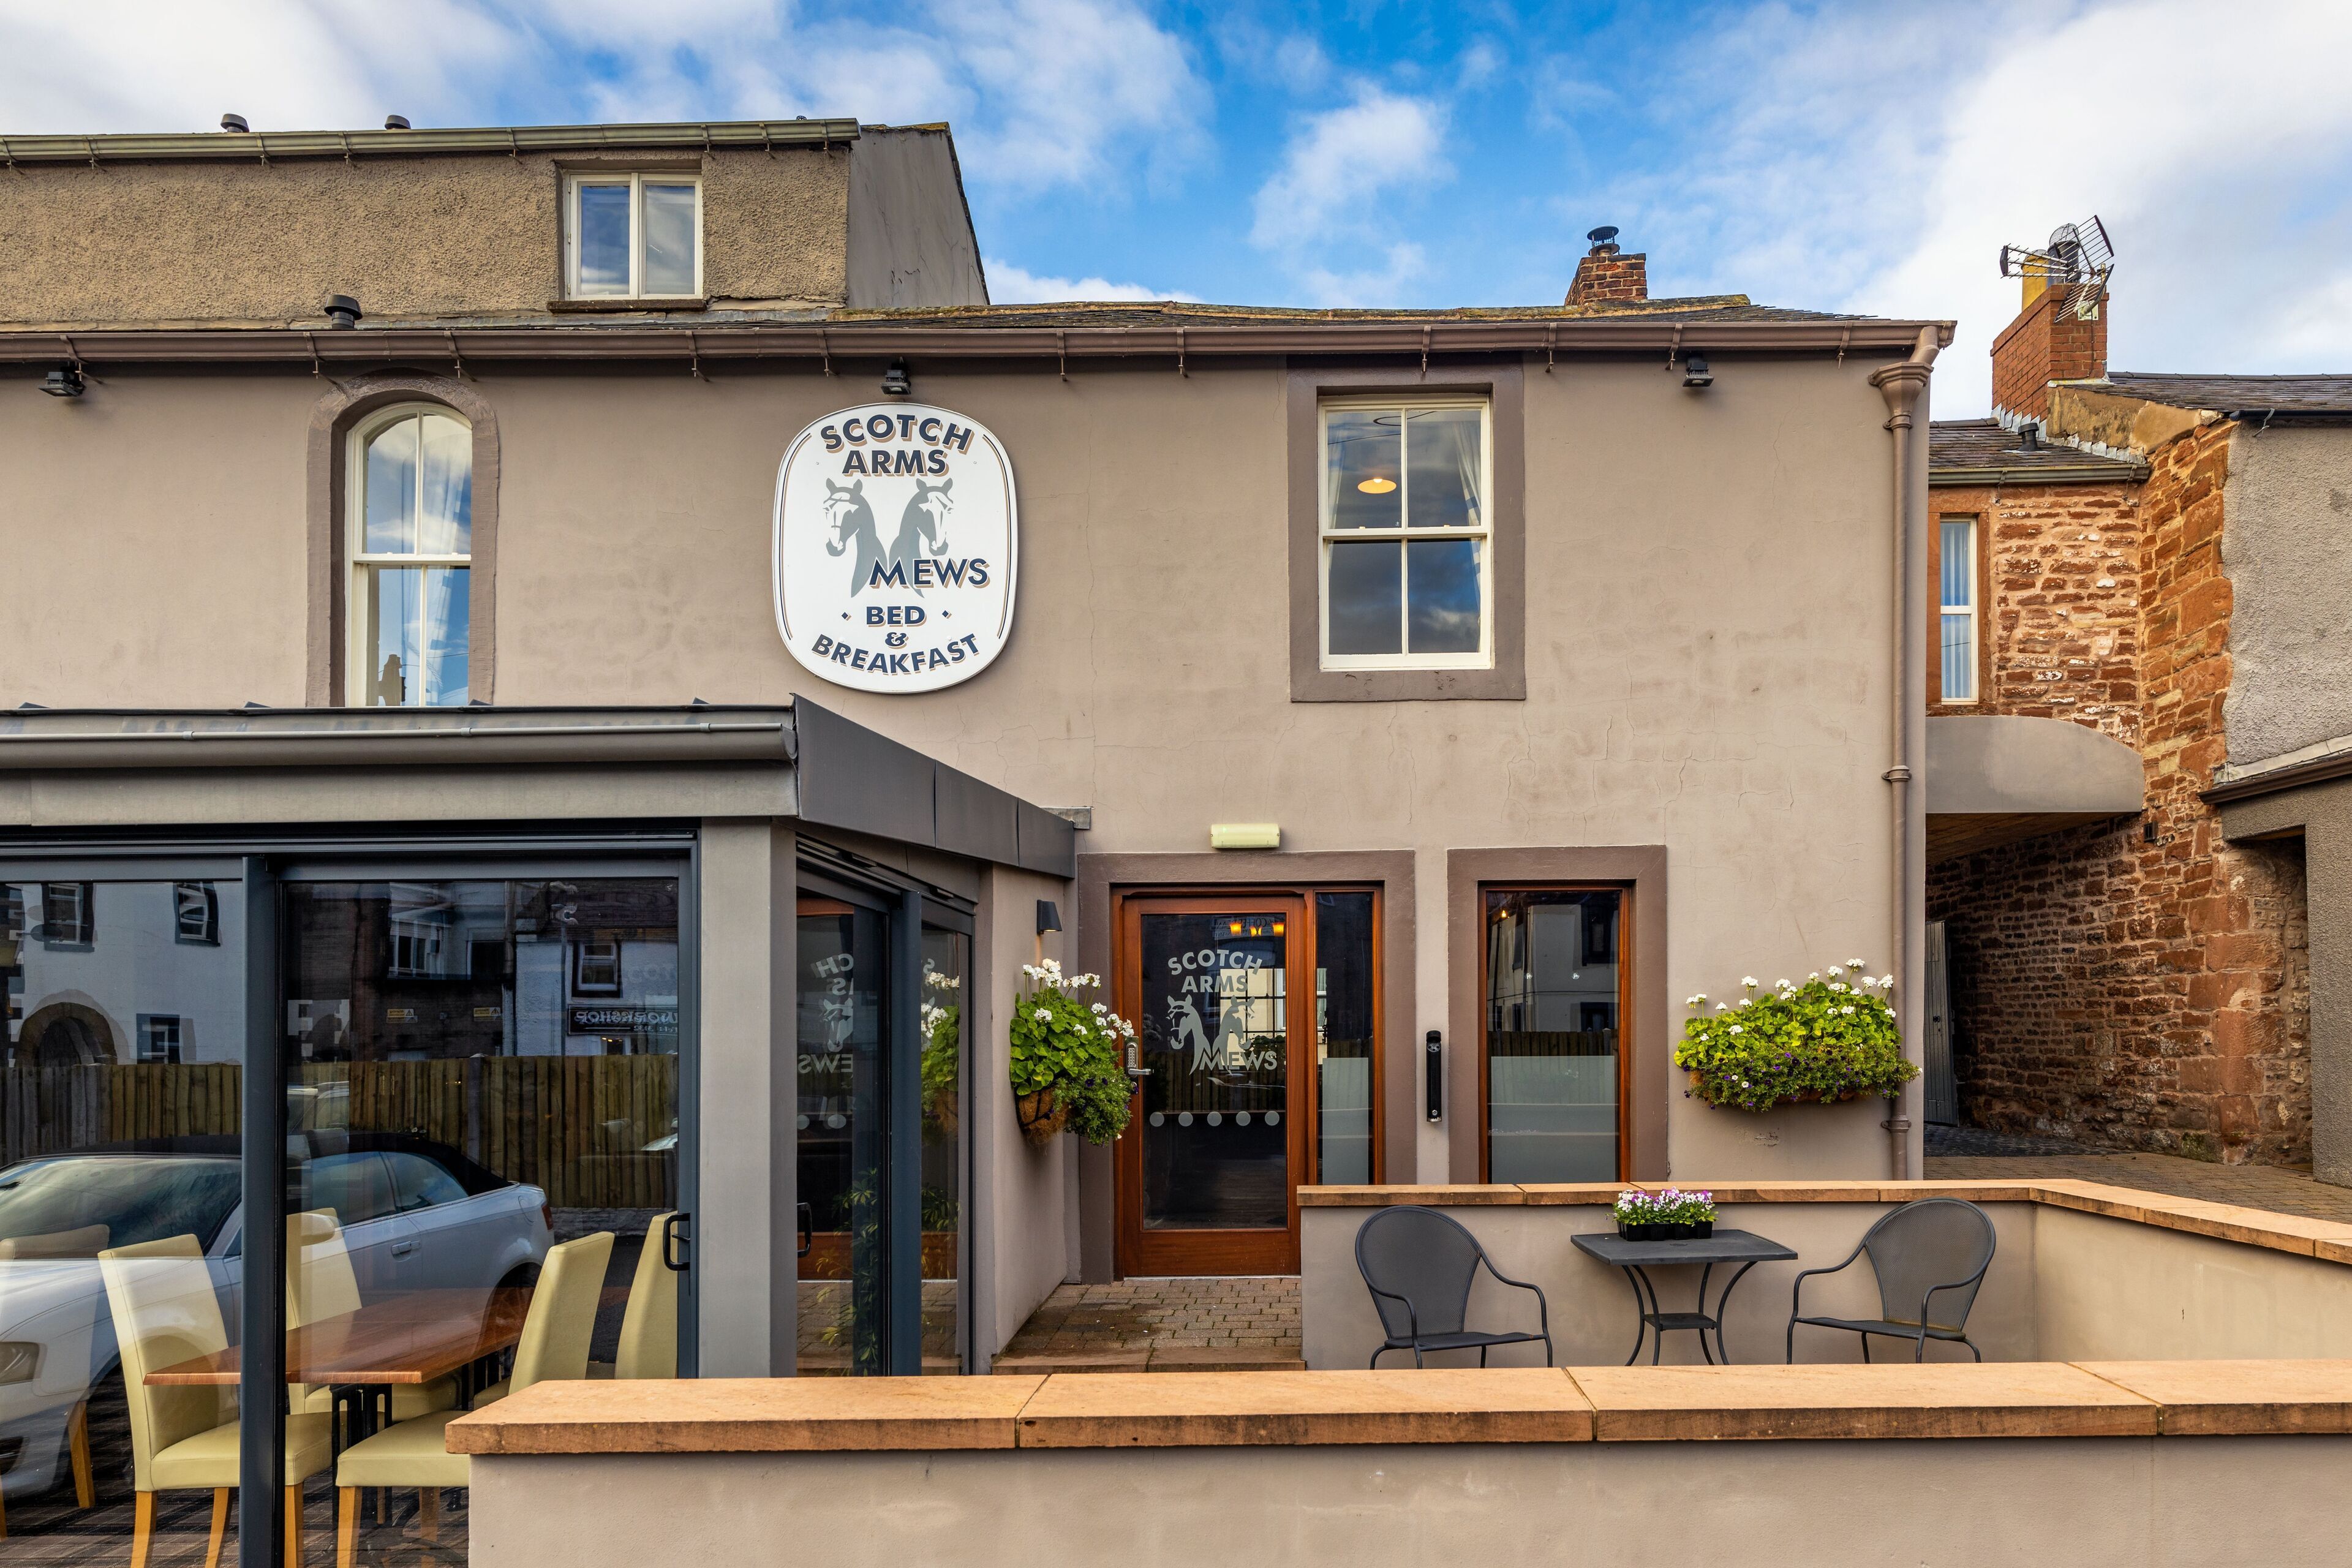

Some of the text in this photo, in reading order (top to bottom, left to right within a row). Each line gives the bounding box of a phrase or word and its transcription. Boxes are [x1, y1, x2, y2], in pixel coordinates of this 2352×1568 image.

[821, 414, 974, 454] SCOTCH
[842, 450, 948, 477] ARMS
[869, 559, 990, 589] MEWS
[866, 606, 926, 627] BED
[885, 632, 908, 649] &
[812, 633, 980, 675] BREAKFAST
[1168, 949, 1262, 975] SCOTCH
[1181, 976, 1248, 993] ARMS
[1199, 1051, 1278, 1071] MEWS
